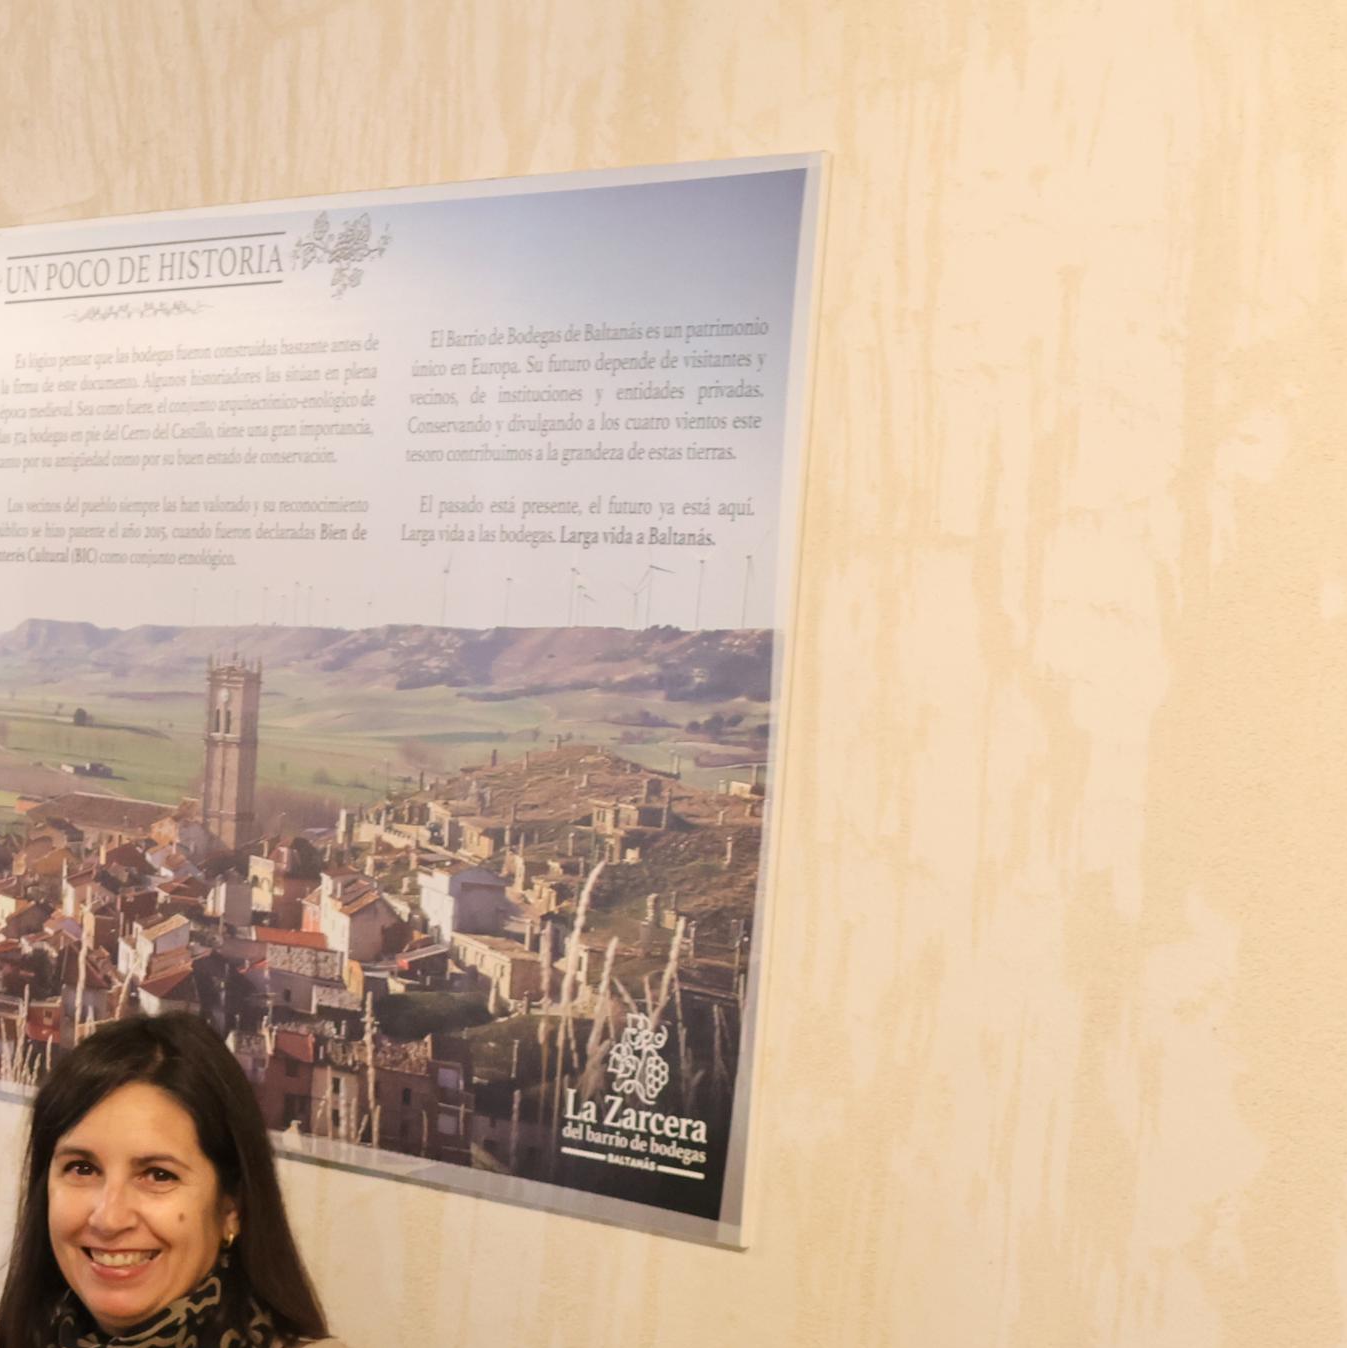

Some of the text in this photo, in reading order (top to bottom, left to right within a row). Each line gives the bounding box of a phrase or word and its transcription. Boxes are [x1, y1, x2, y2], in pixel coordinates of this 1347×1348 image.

[6, 243, 283, 294] UN POCO DE HISTORIA
[430, 316, 769, 349] El Barrio de Bodegas de Baltanás es un patrimonio
[411, 349, 765, 379] único en Europa. Su futuro depende de visitantes y
[409, 379, 765, 407] vecinos, de instituciones y entidades privadas.
[406, 411, 762, 438] Conservando y divulgando a los cuatro vientos este
[405, 441, 736, 466] tesoro contribuimos a la grandeza de estas tierras.
[419, 495, 755, 521] El pasado está presente, el futuro ya está aquí.
[319, 522, 348, 540] Bien
[400, 522, 716, 549] Larga vida a las bodegas. Larga vida a Baltanás.
[70, 545, 98, 568] (BIC)
[564, 1087, 708, 1143] La Zarcera
[562, 1121, 707, 1165] del barrio de bodegas
[607, 1153, 657, 1172] BALTANÁS
